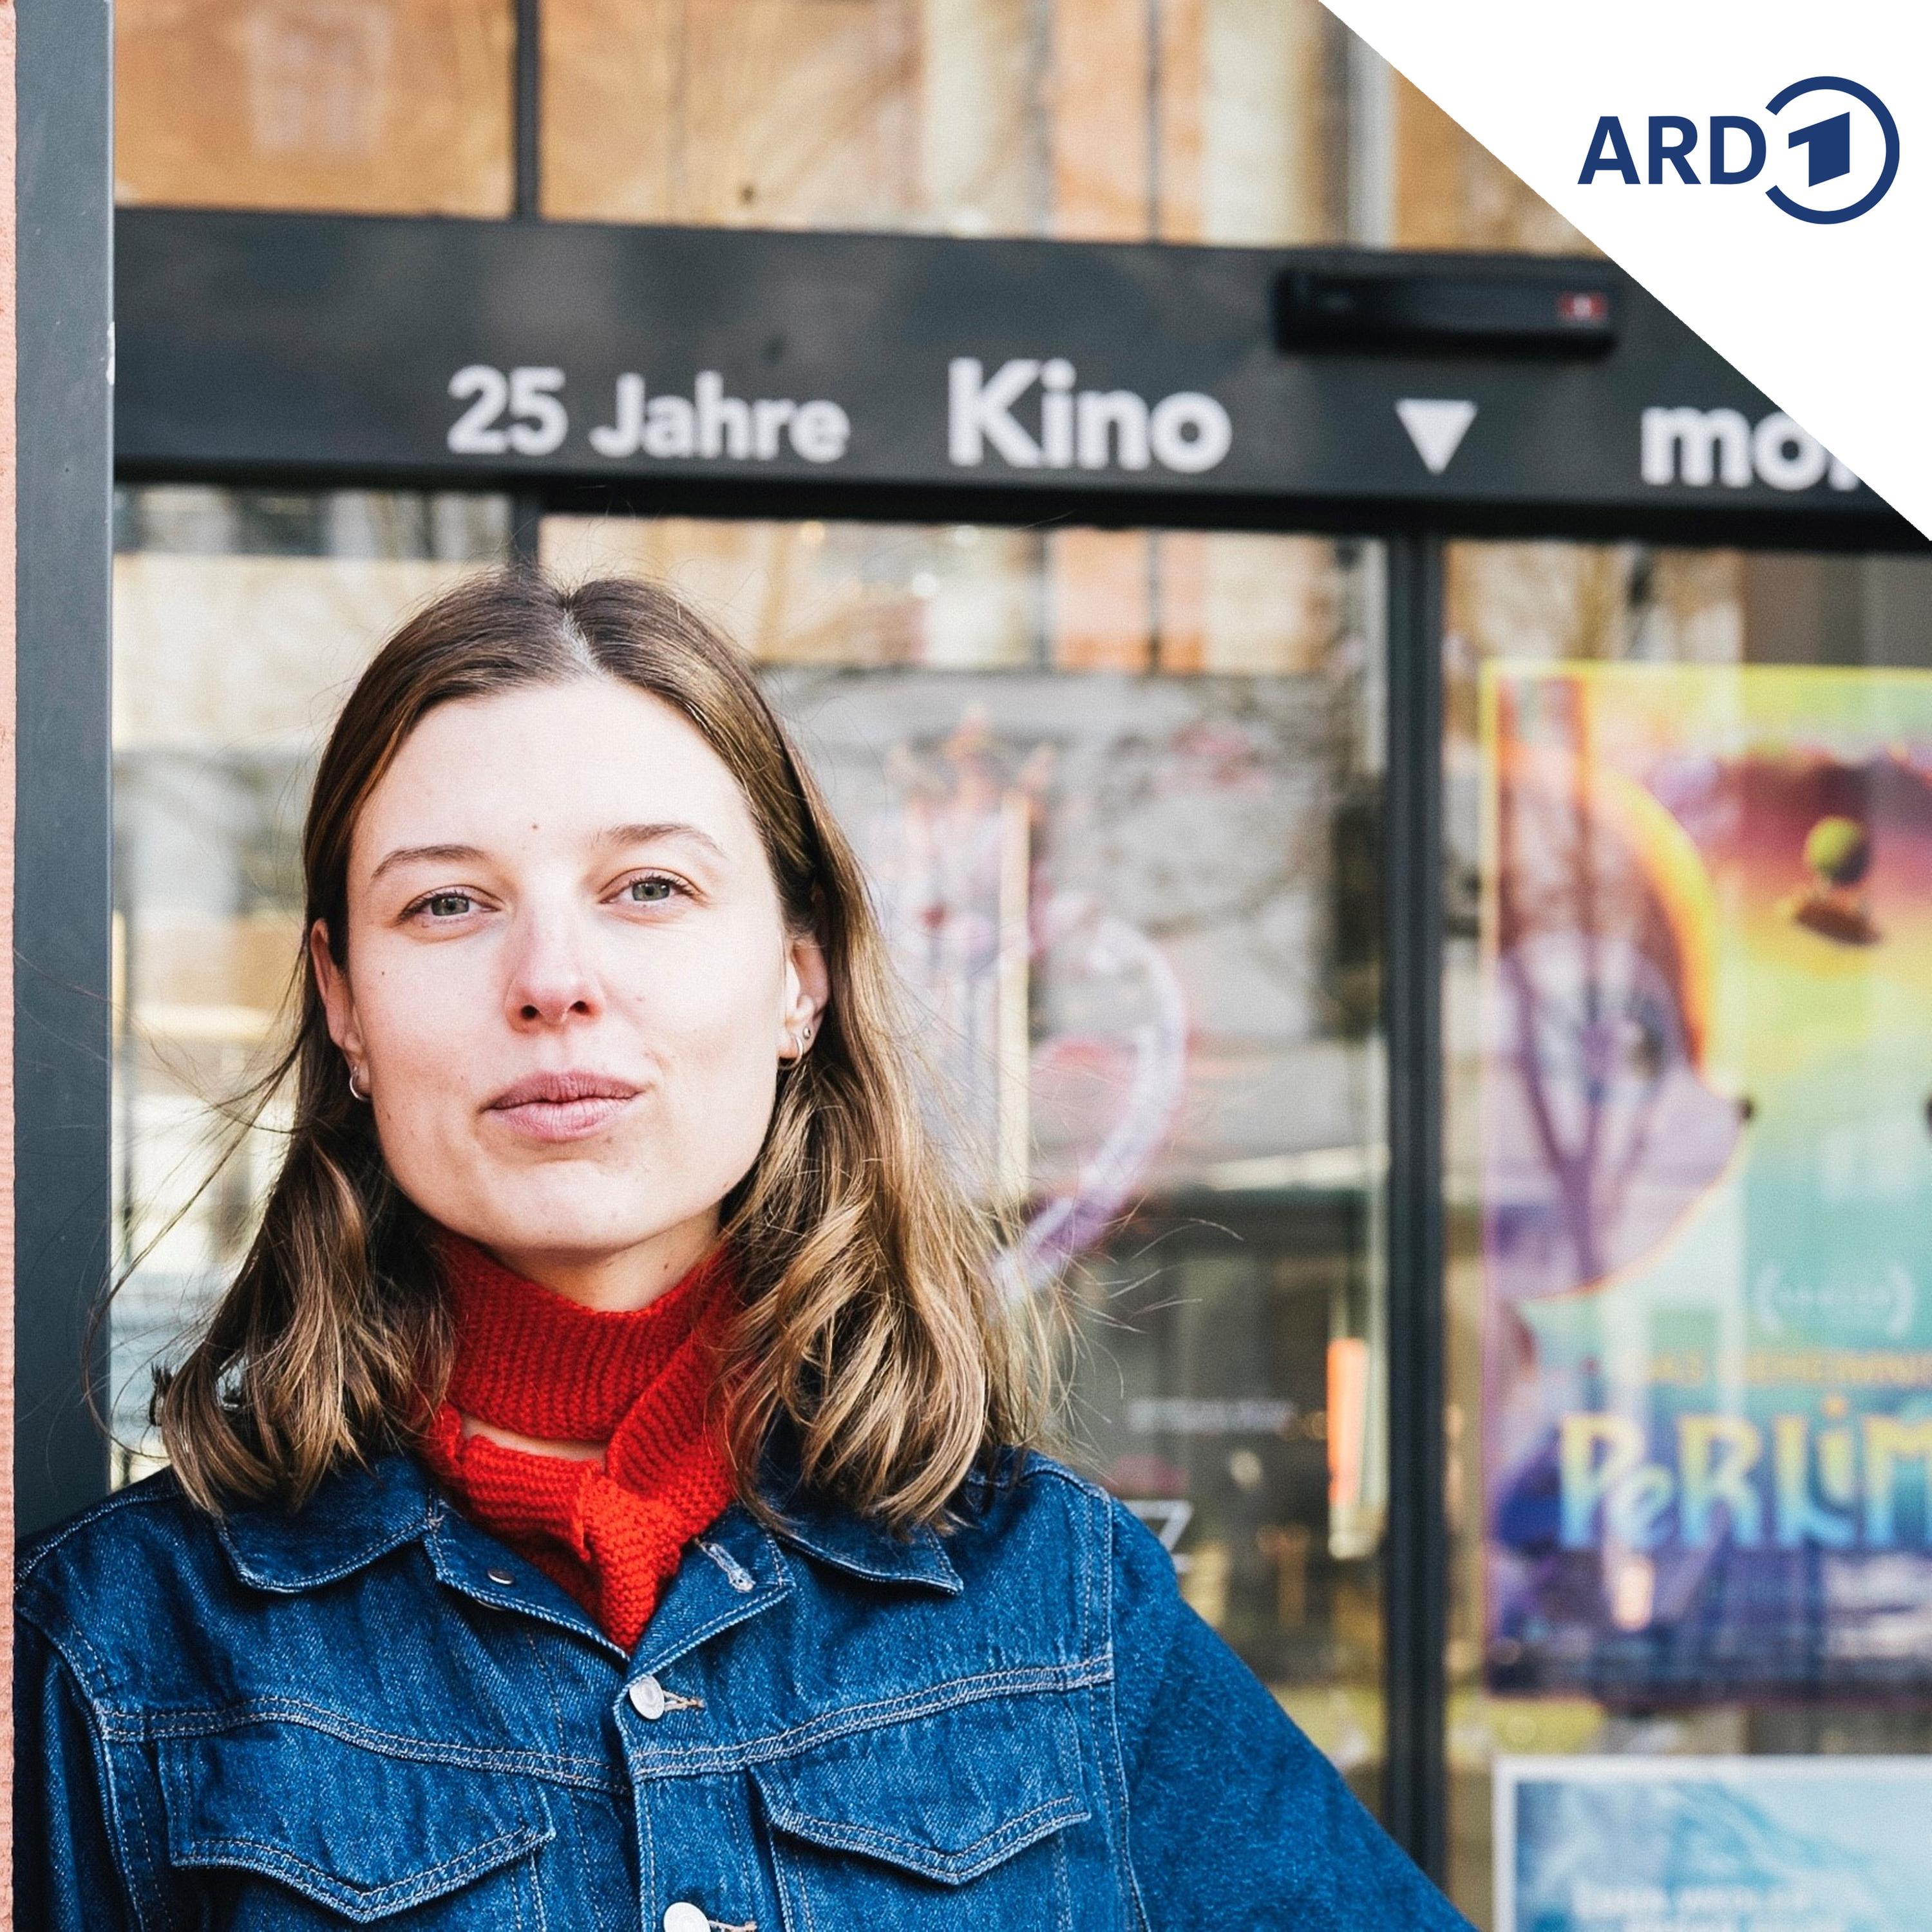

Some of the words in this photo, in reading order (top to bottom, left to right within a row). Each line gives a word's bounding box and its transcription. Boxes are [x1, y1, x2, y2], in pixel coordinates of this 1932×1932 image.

[447, 365, 569, 455] 25
[589, 370, 851, 463] Jahre
[947, 357, 1232, 473] Kino
